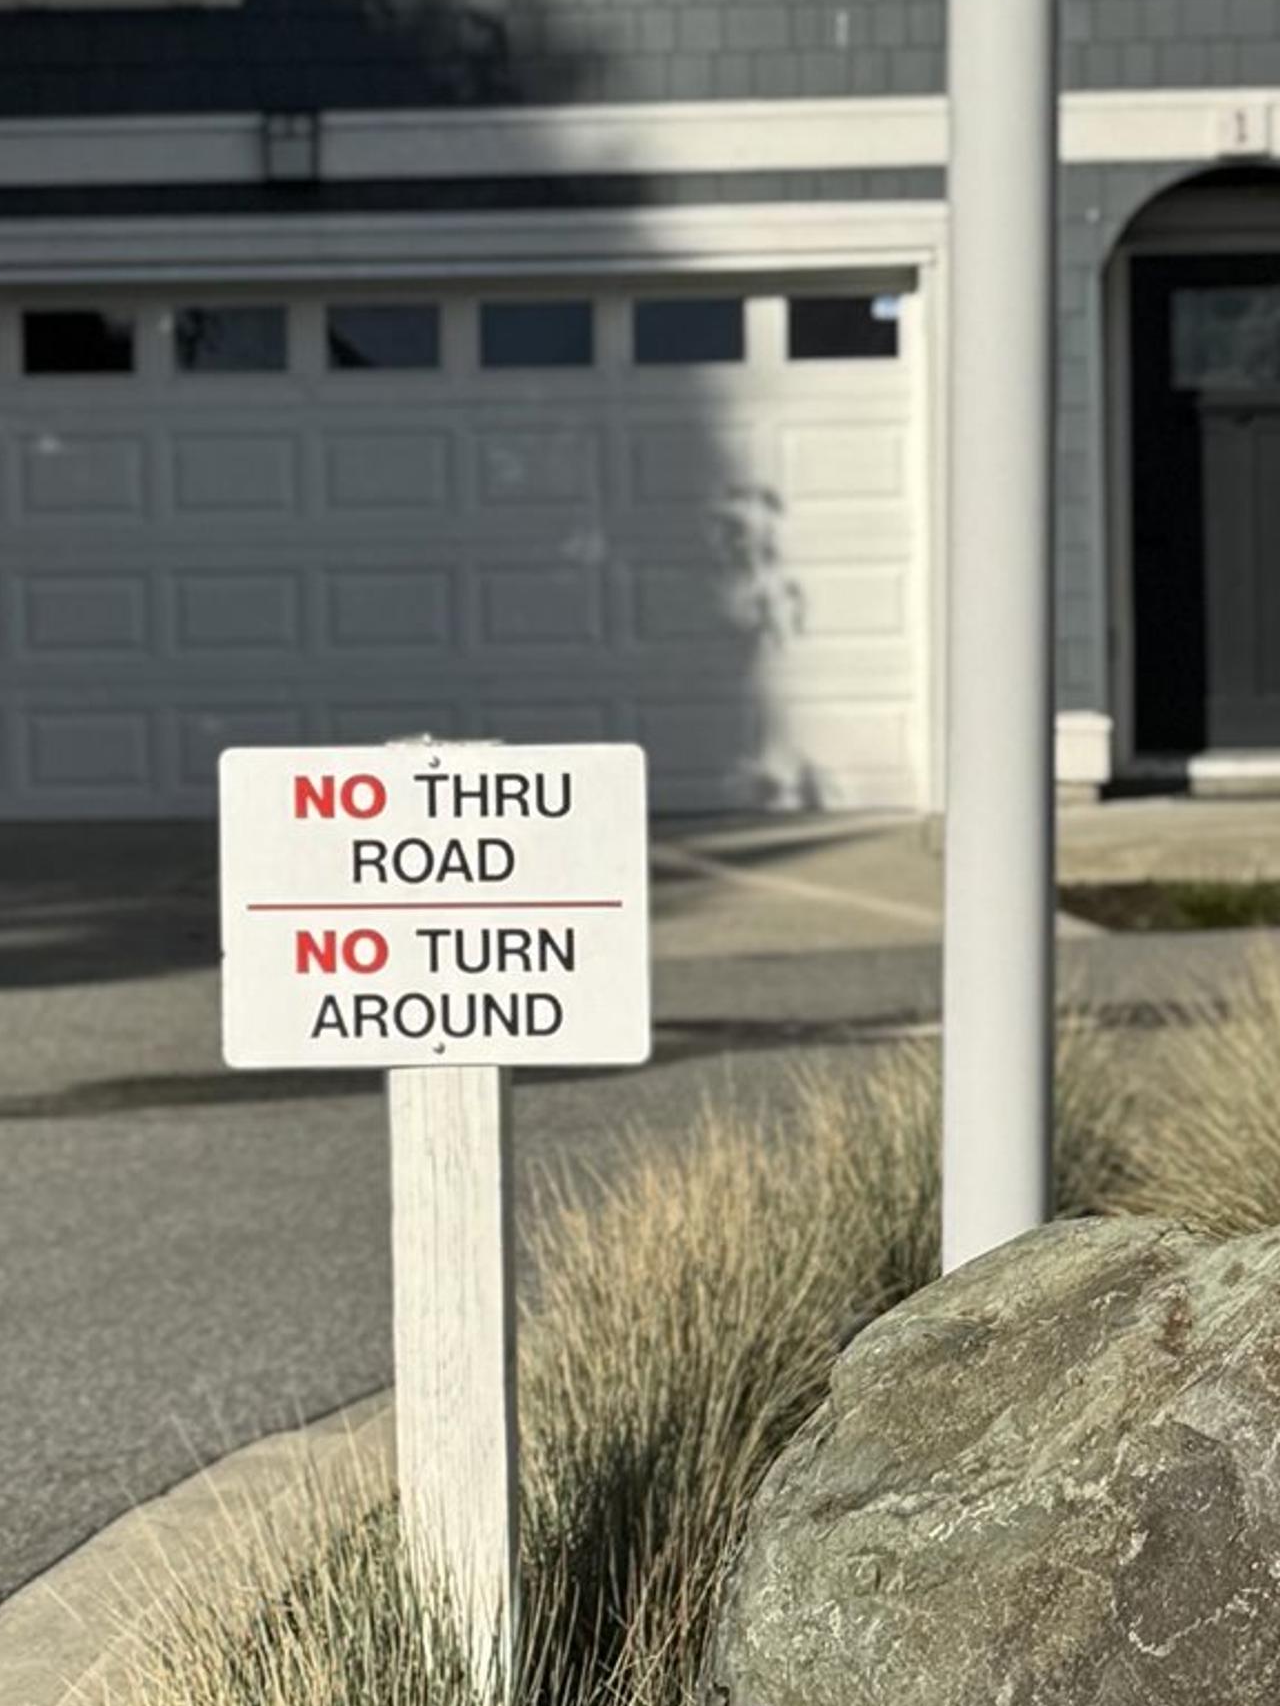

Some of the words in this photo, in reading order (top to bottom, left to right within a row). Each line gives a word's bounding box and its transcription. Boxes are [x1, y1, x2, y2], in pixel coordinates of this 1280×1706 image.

[294, 774, 387, 819] NO
[414, 773, 572, 818] THRU
[353, 838, 516, 883] ROAD
[295, 928, 389, 974] NO
[416, 928, 576, 972] TURN
[311, 993, 564, 1039] AROUND
